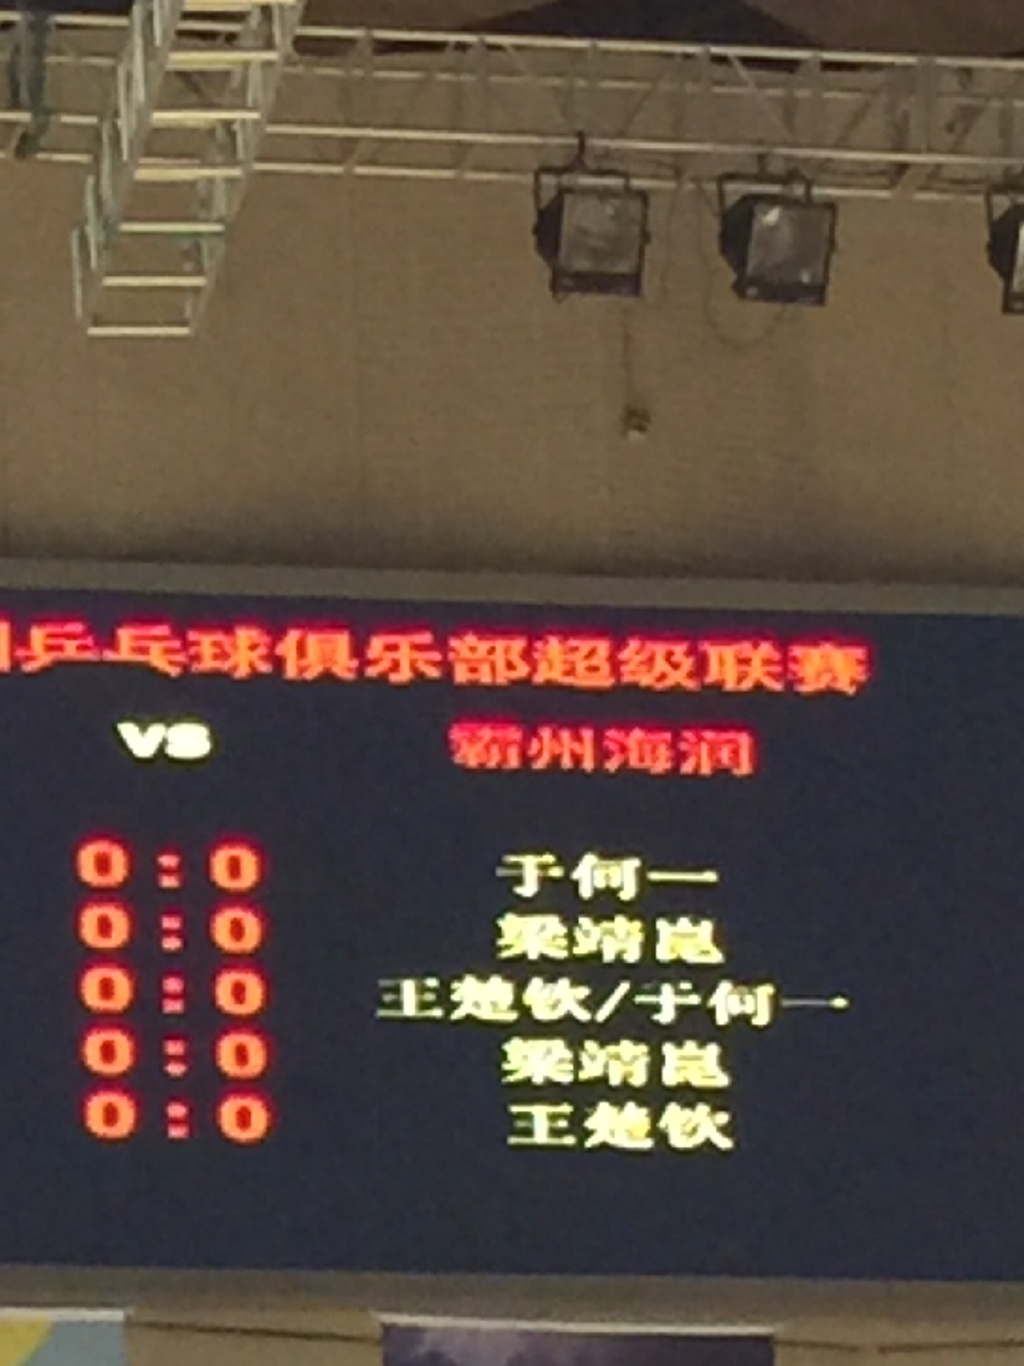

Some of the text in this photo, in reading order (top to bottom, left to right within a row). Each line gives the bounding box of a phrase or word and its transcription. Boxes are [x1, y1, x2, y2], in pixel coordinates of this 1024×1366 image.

[448, 719, 758, 777] 霸州海润
[496, 853, 720, 902] 于何一
[507, 1101, 736, 1151] 王楚钦
